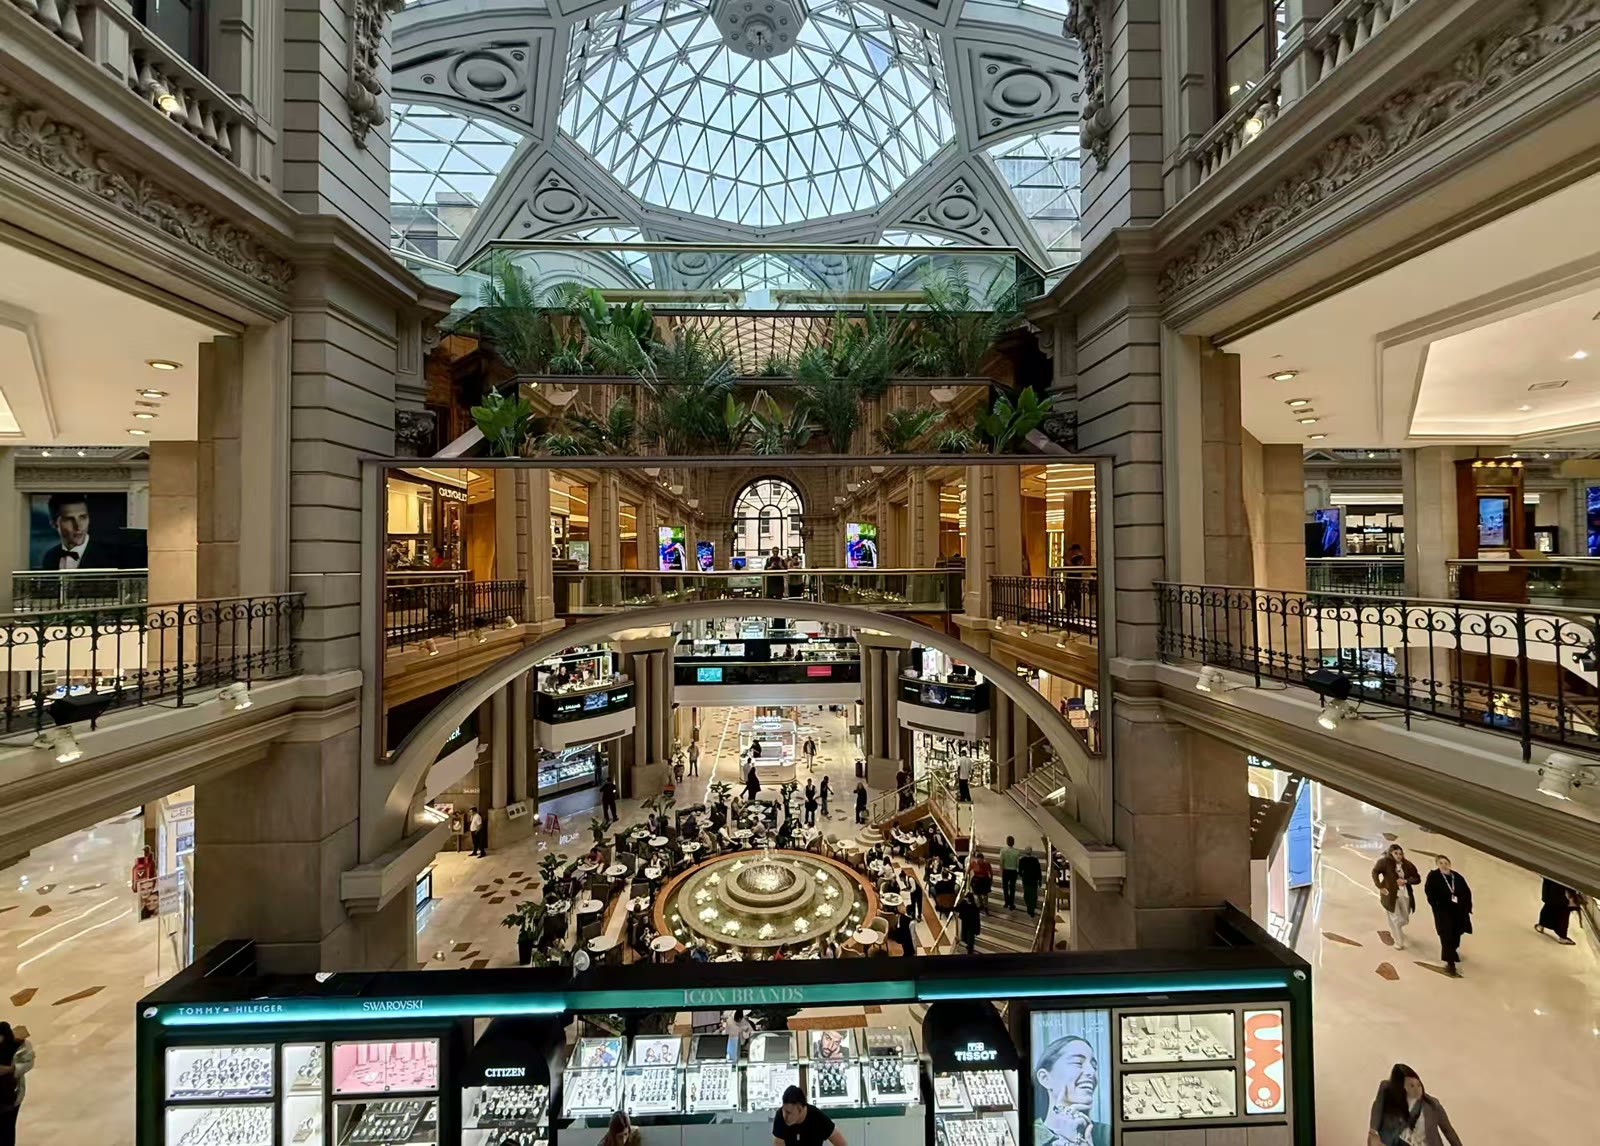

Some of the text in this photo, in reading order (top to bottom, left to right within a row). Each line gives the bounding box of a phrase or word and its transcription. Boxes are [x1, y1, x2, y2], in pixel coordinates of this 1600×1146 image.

[684, 987, 804, 1006] ICON BRANDS
[179, 1004, 283, 1015] TOMMY HILFIGER
[363, 1000, 423, 1011] SWAROVSKI
[954, 1050, 998, 1061] TISSOT
[484, 1067, 526, 1078] CITIZEN
